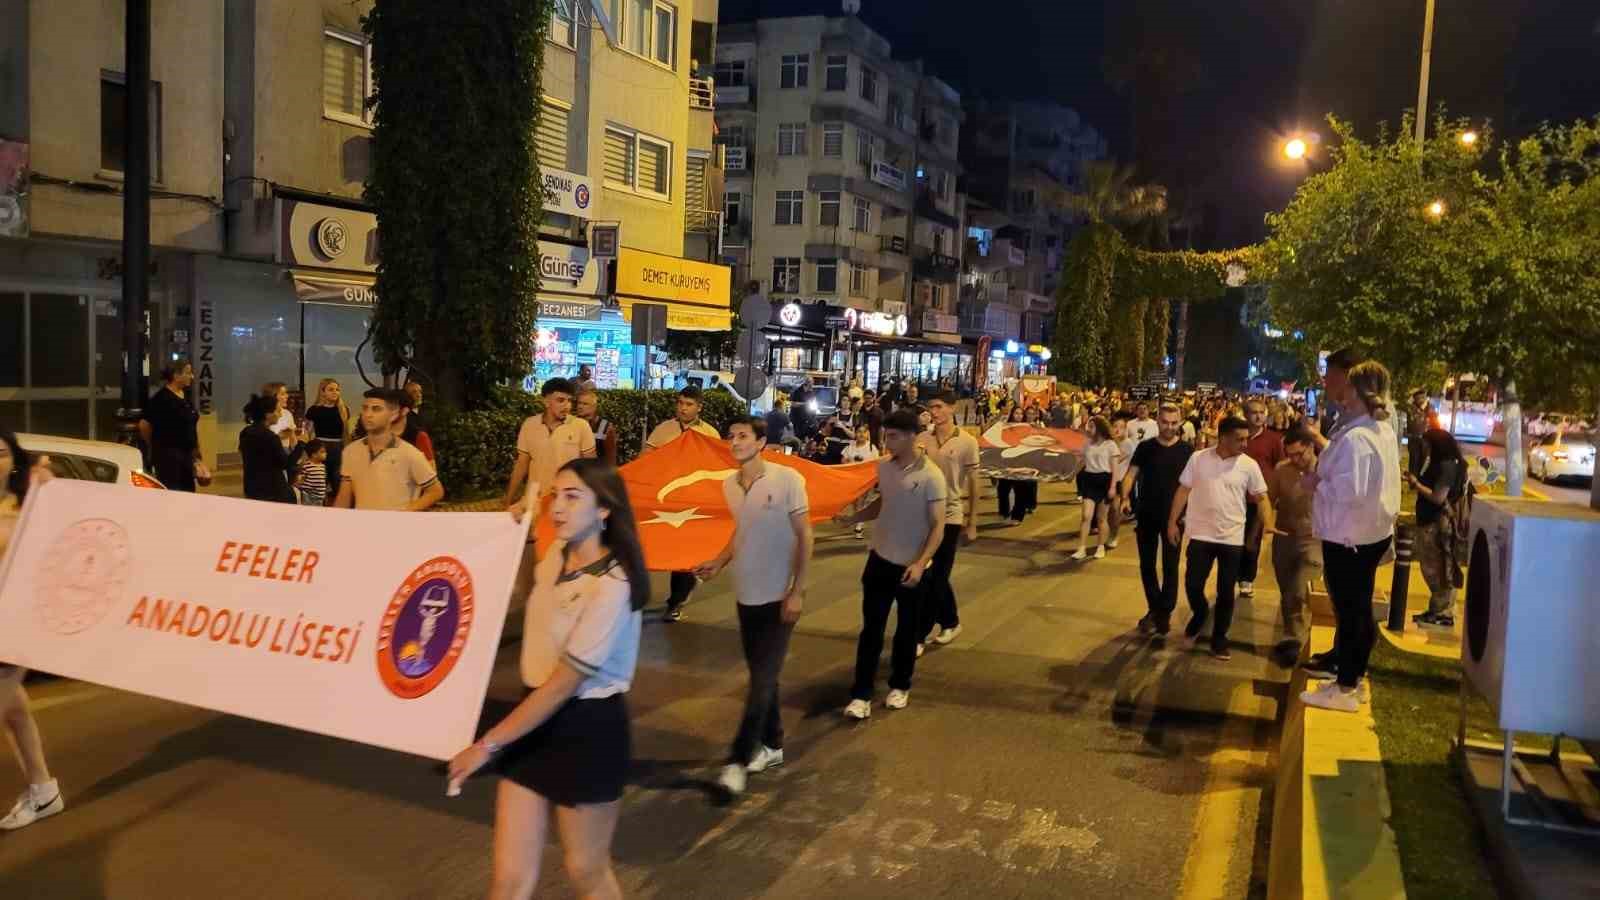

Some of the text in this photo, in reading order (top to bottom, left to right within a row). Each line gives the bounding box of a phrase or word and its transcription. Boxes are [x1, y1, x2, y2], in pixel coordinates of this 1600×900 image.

[642, 268, 668, 285] DEMET
[200, 307, 213, 415] ECZANE
[215, 541, 320, 583] EFELER
[126, 596, 364, 664] ANADOLU LİSESİ
